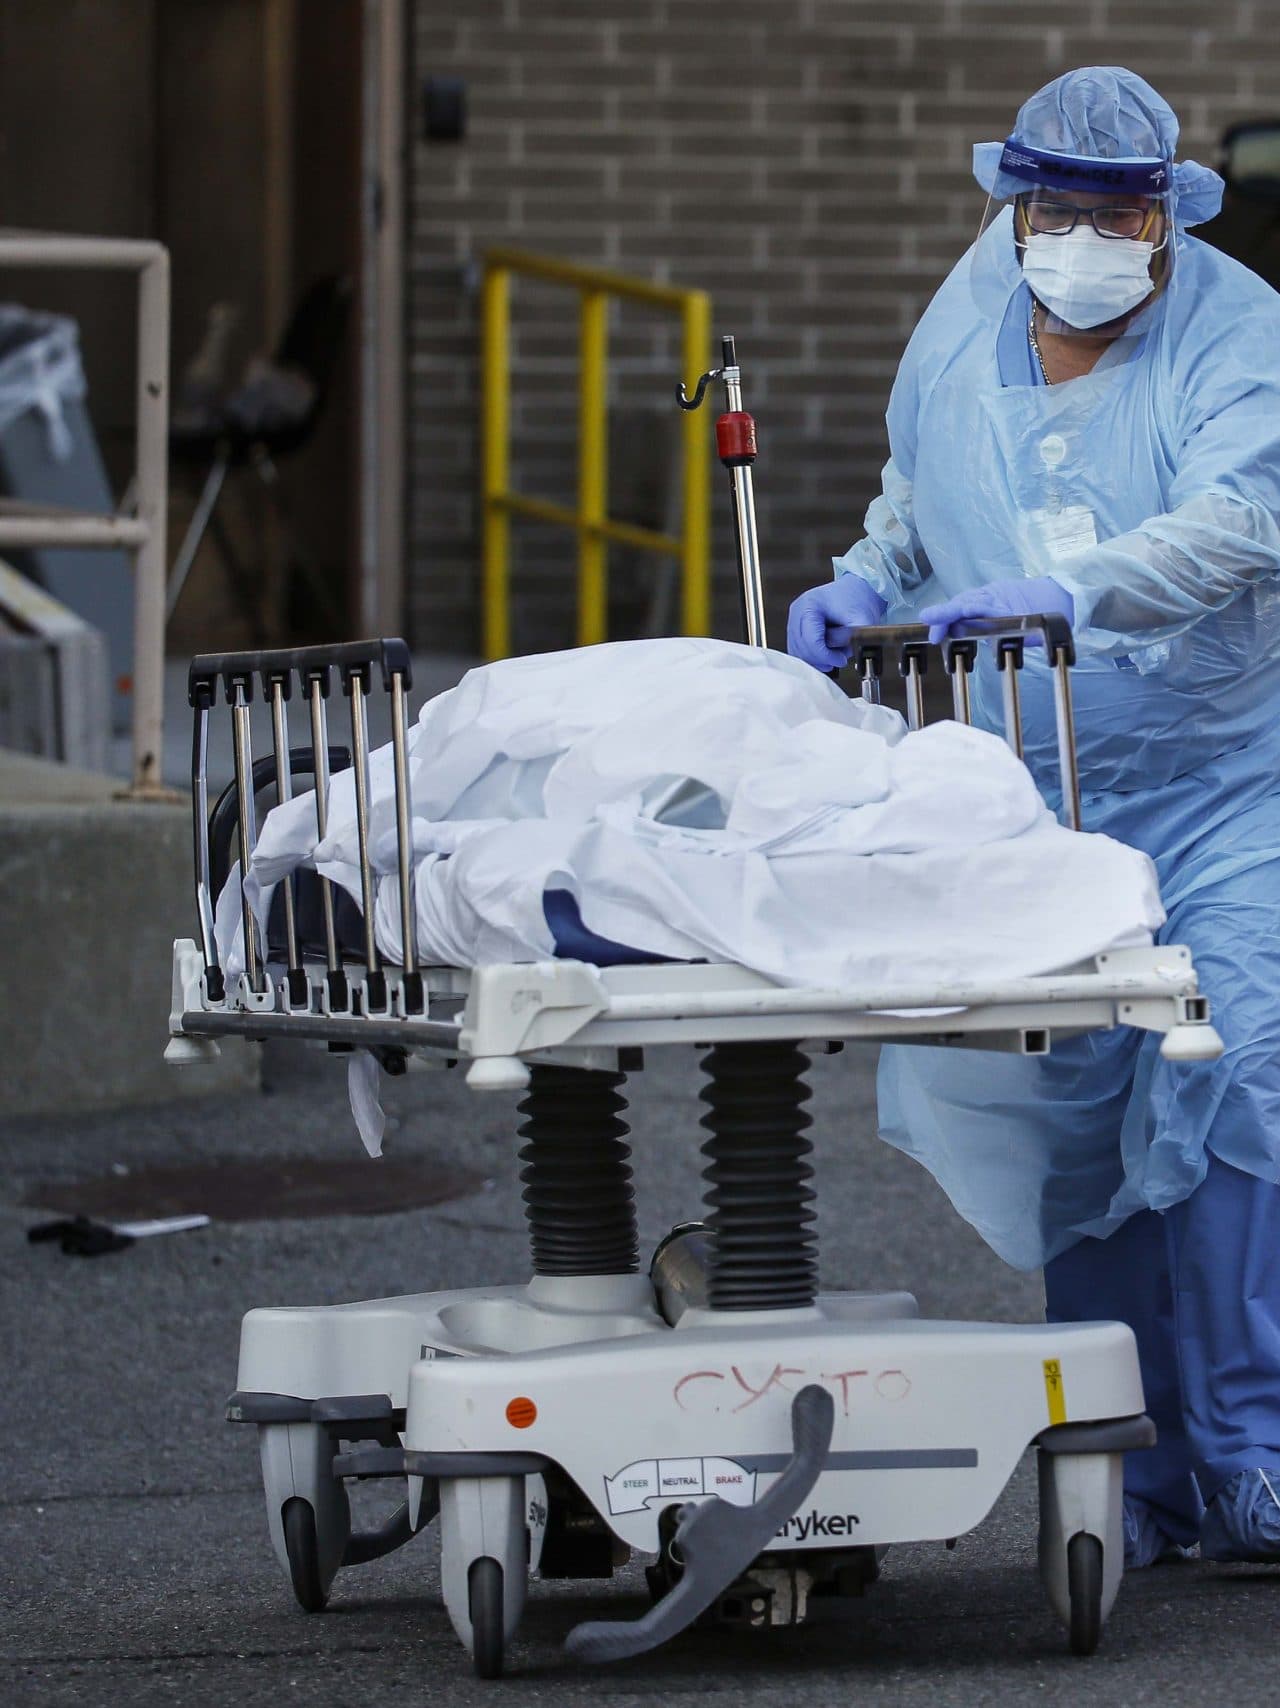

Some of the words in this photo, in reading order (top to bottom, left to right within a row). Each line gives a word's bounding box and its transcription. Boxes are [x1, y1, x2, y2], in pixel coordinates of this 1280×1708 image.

[623, 1479, 649, 1488] STEER
[662, 1477, 699, 1486] NEUTRAL
[715, 1474, 743, 1484] BRAKE
[776, 1509, 860, 1542] ryker
